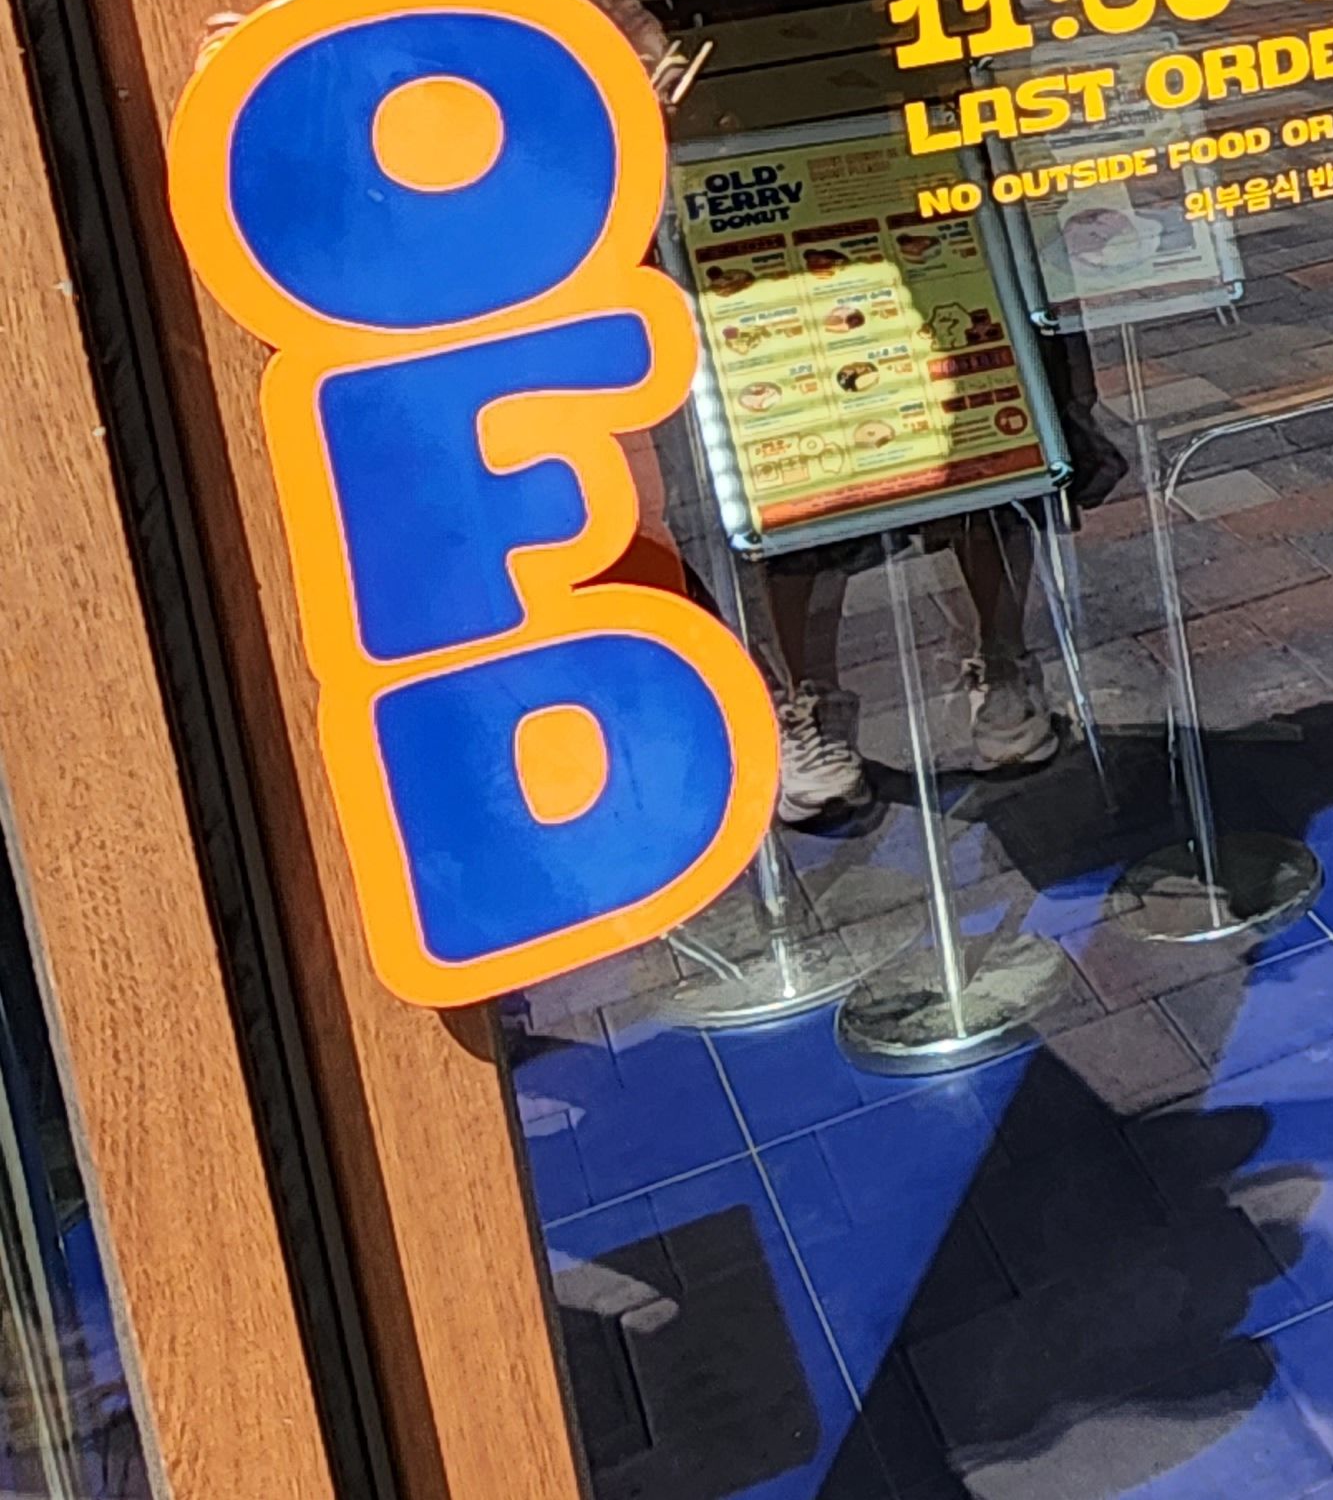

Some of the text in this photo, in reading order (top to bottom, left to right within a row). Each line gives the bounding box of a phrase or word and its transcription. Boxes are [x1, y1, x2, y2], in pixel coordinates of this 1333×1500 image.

[904, 68, 1113, 156] LAST
[705, 165, 778, 193] OLD
[917, 182, 980, 219] NO
[991, 145, 1157, 206] OUTSIDE
[1166, 125, 1269, 171] FOOD
[684, 181, 802, 220] FERRY
[710, 206, 790, 233] DONUT
[1184, 176, 1299, 223] 외부음식
